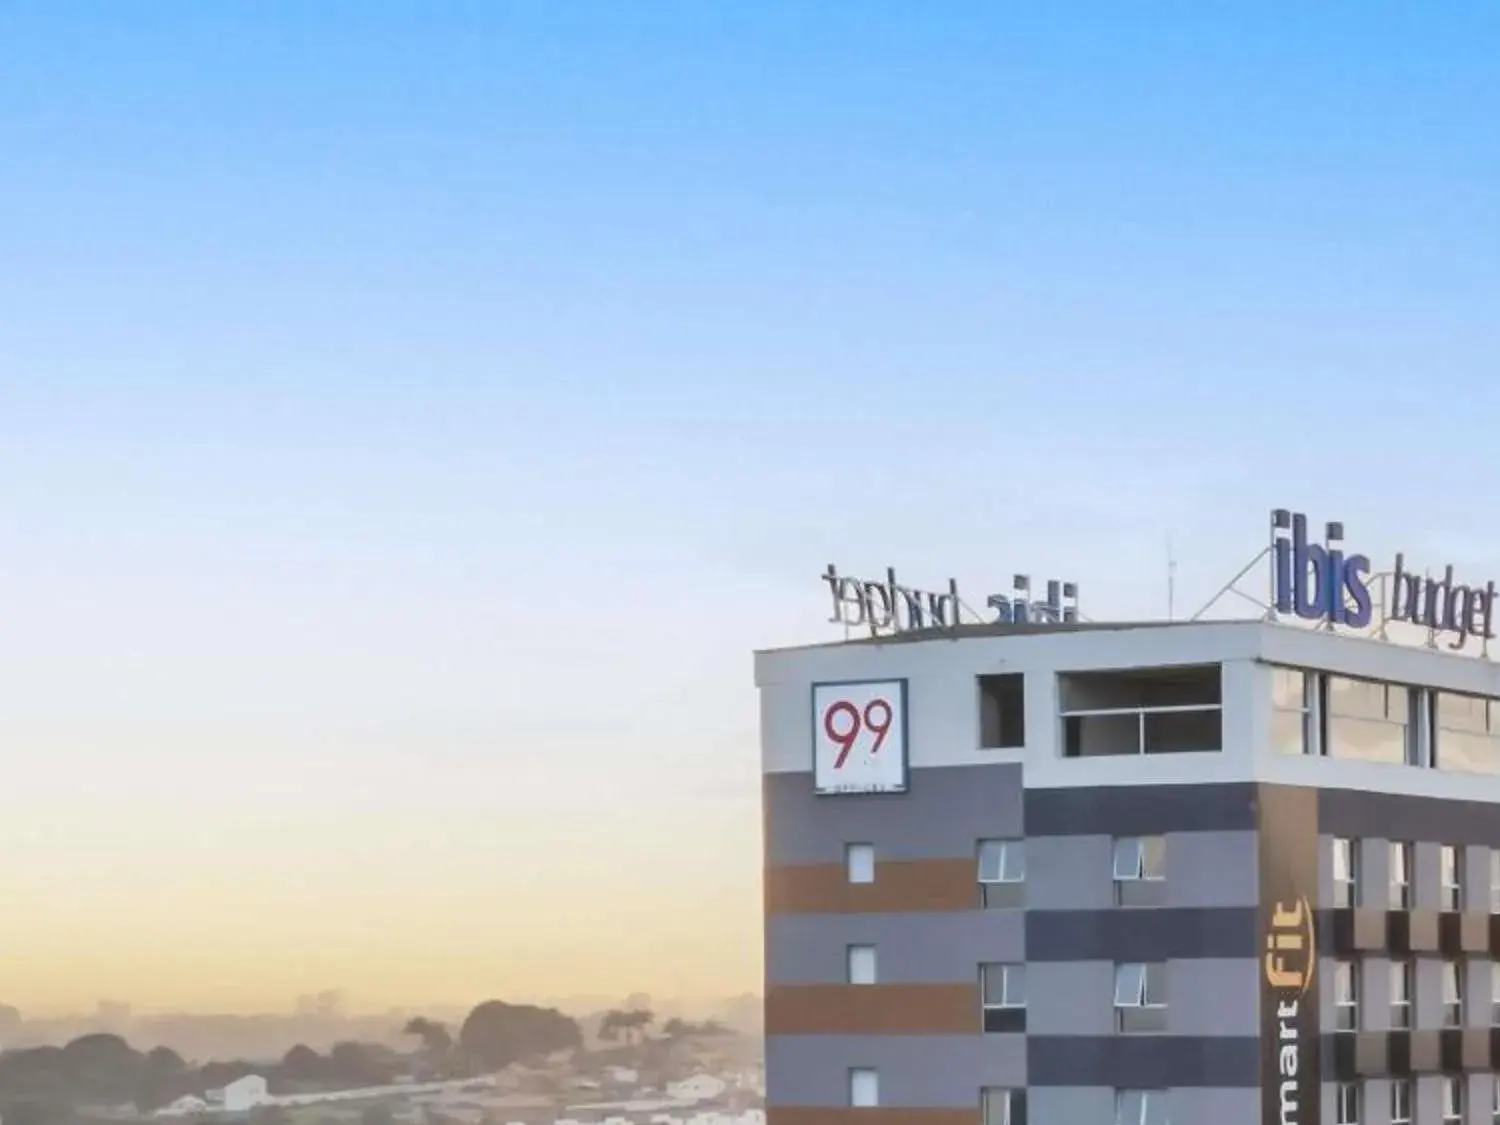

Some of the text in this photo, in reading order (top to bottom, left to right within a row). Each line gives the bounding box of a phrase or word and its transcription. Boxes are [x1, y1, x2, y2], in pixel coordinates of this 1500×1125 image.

[1270, 508, 1499, 649] ibis budget
[824, 699, 893, 769] 99
[1265, 897, 1307, 988] fit
